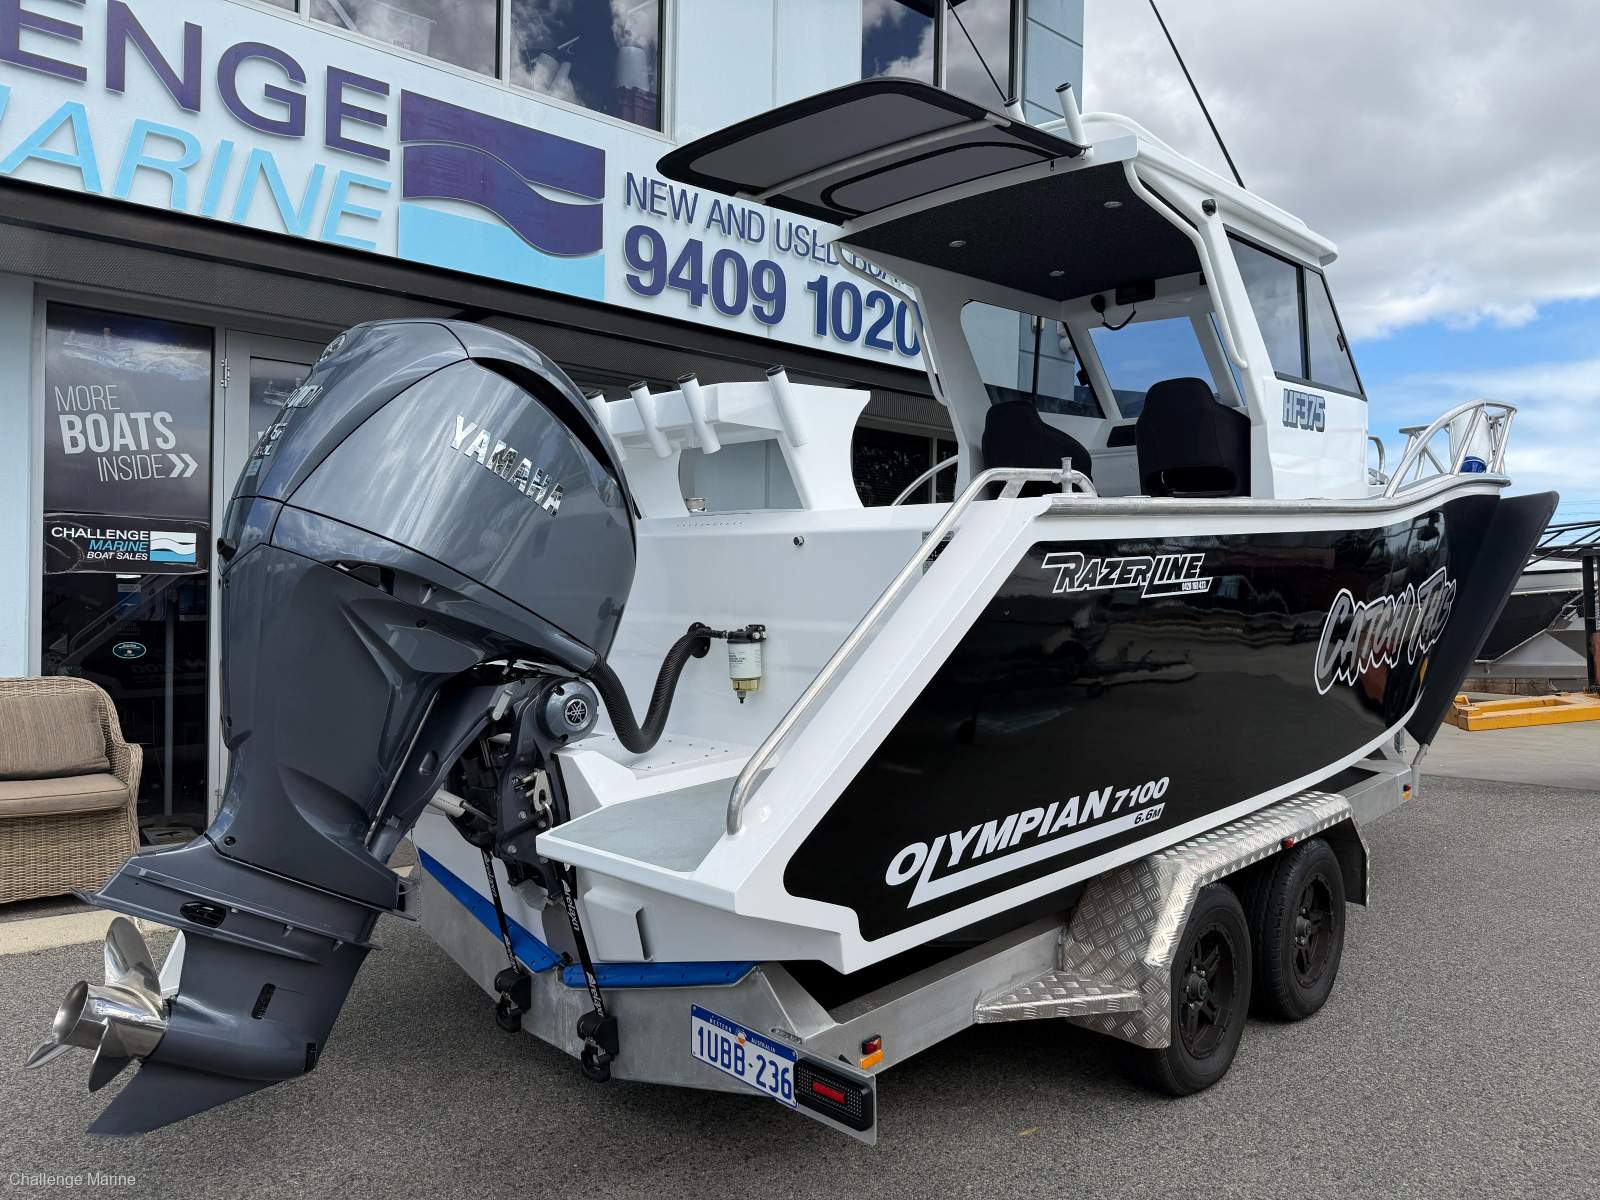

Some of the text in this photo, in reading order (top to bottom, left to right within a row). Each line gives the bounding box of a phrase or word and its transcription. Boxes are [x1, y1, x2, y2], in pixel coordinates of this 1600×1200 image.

[0, 82, 392, 250] ARINE
[626, 171, 699, 224] NEW
[705, 198, 765, 243] AND
[624, 225, 923, 357] 9409 1020
[55, 385, 120, 412] MORE
[1282, 388, 1325, 432] HF375
[59, 411, 177, 454] BOATS
[97, 454, 166, 482] INSIDE
[450, 414, 563, 518] YAMAHA
[51, 527, 149, 541] CHALLENGE
[89, 539, 149, 552] MARINE
[87, 551, 148, 560] BOAT SALES
[1134, 807, 1163, 825] 6.6M
[885, 777, 1170, 908] OLYMPIAN 7100
[709, 1018, 776, 1053] WESTERN AUSTRALIA
